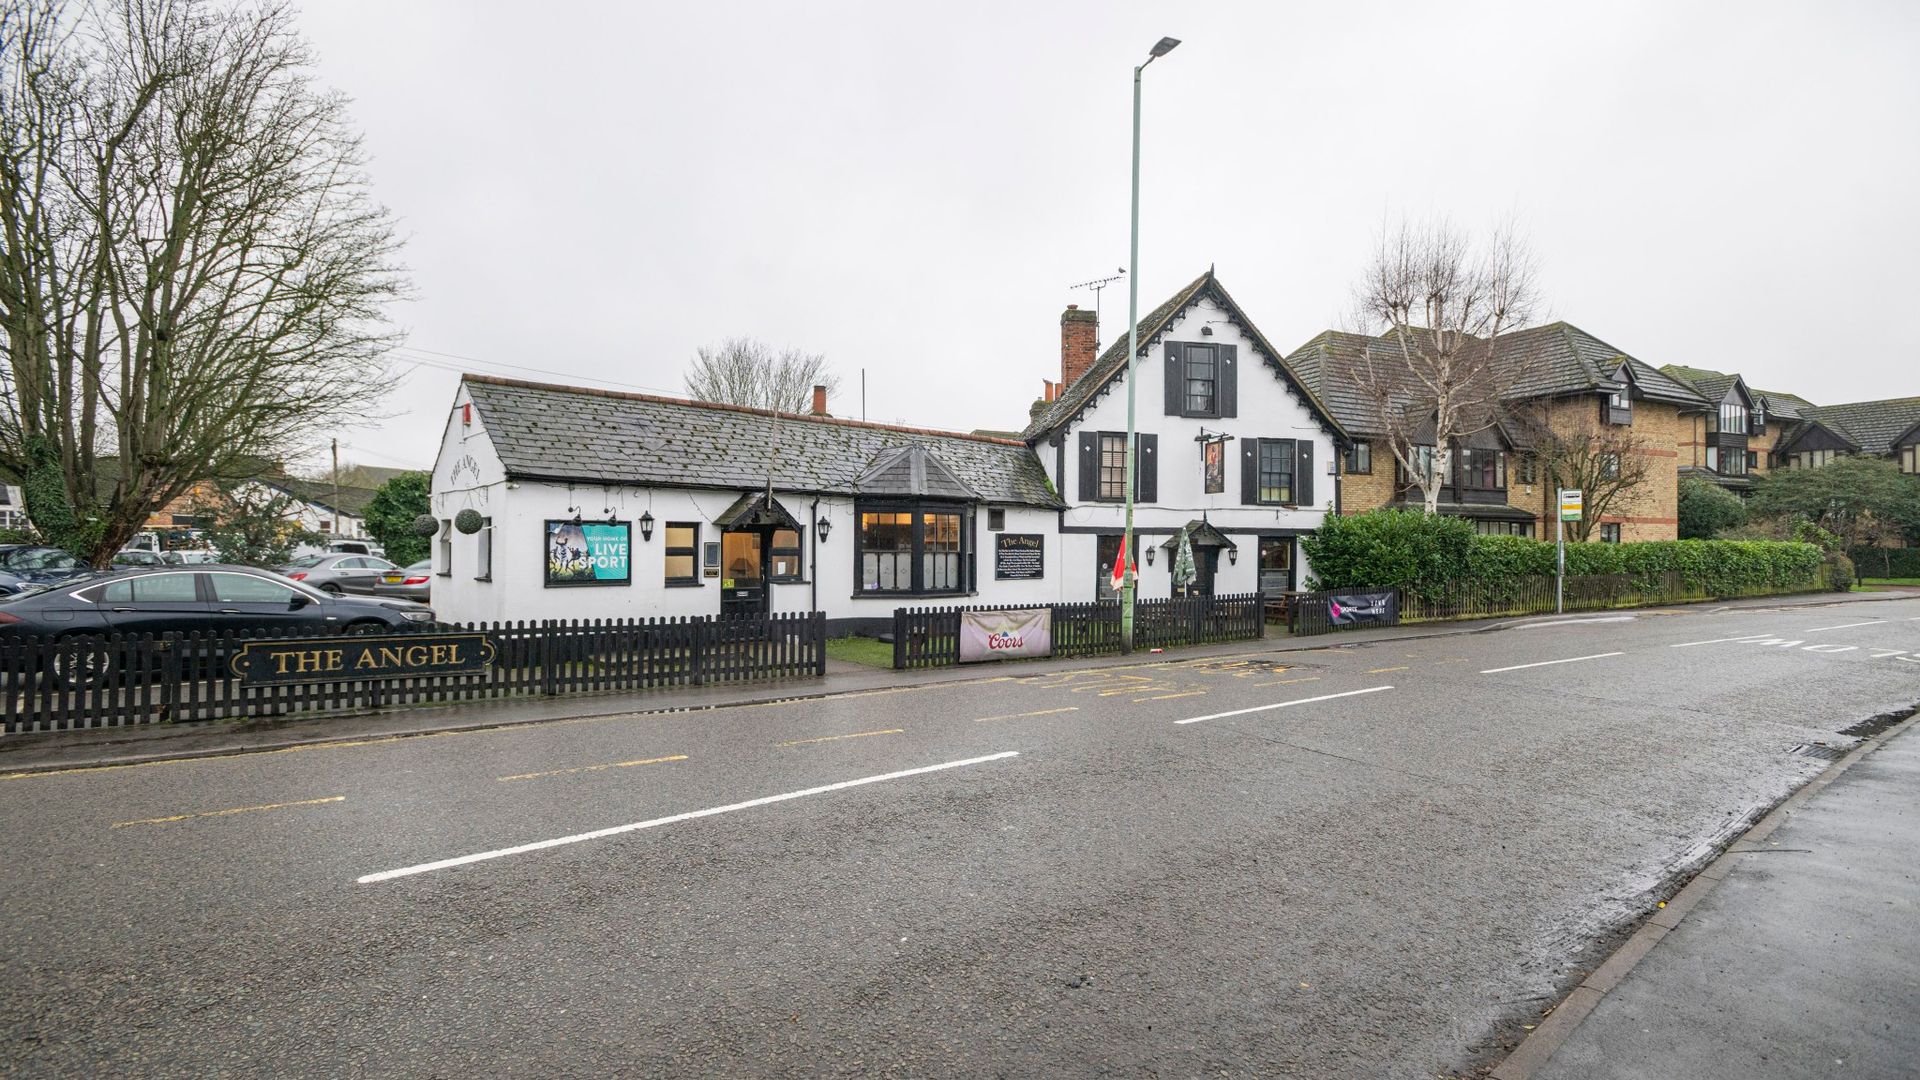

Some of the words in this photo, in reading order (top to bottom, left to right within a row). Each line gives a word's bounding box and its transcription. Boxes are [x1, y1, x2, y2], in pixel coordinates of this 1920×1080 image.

[1001, 538, 1017, 547] The
[1019, 536, 1039, 547] Angel
[595, 543, 627, 555] LIVE
[580, 556, 627, 569] SPORT
[988, 633, 1024, 650] Coors
[270, 649, 344, 674] THE
[354, 644, 466, 670] ANGEL
